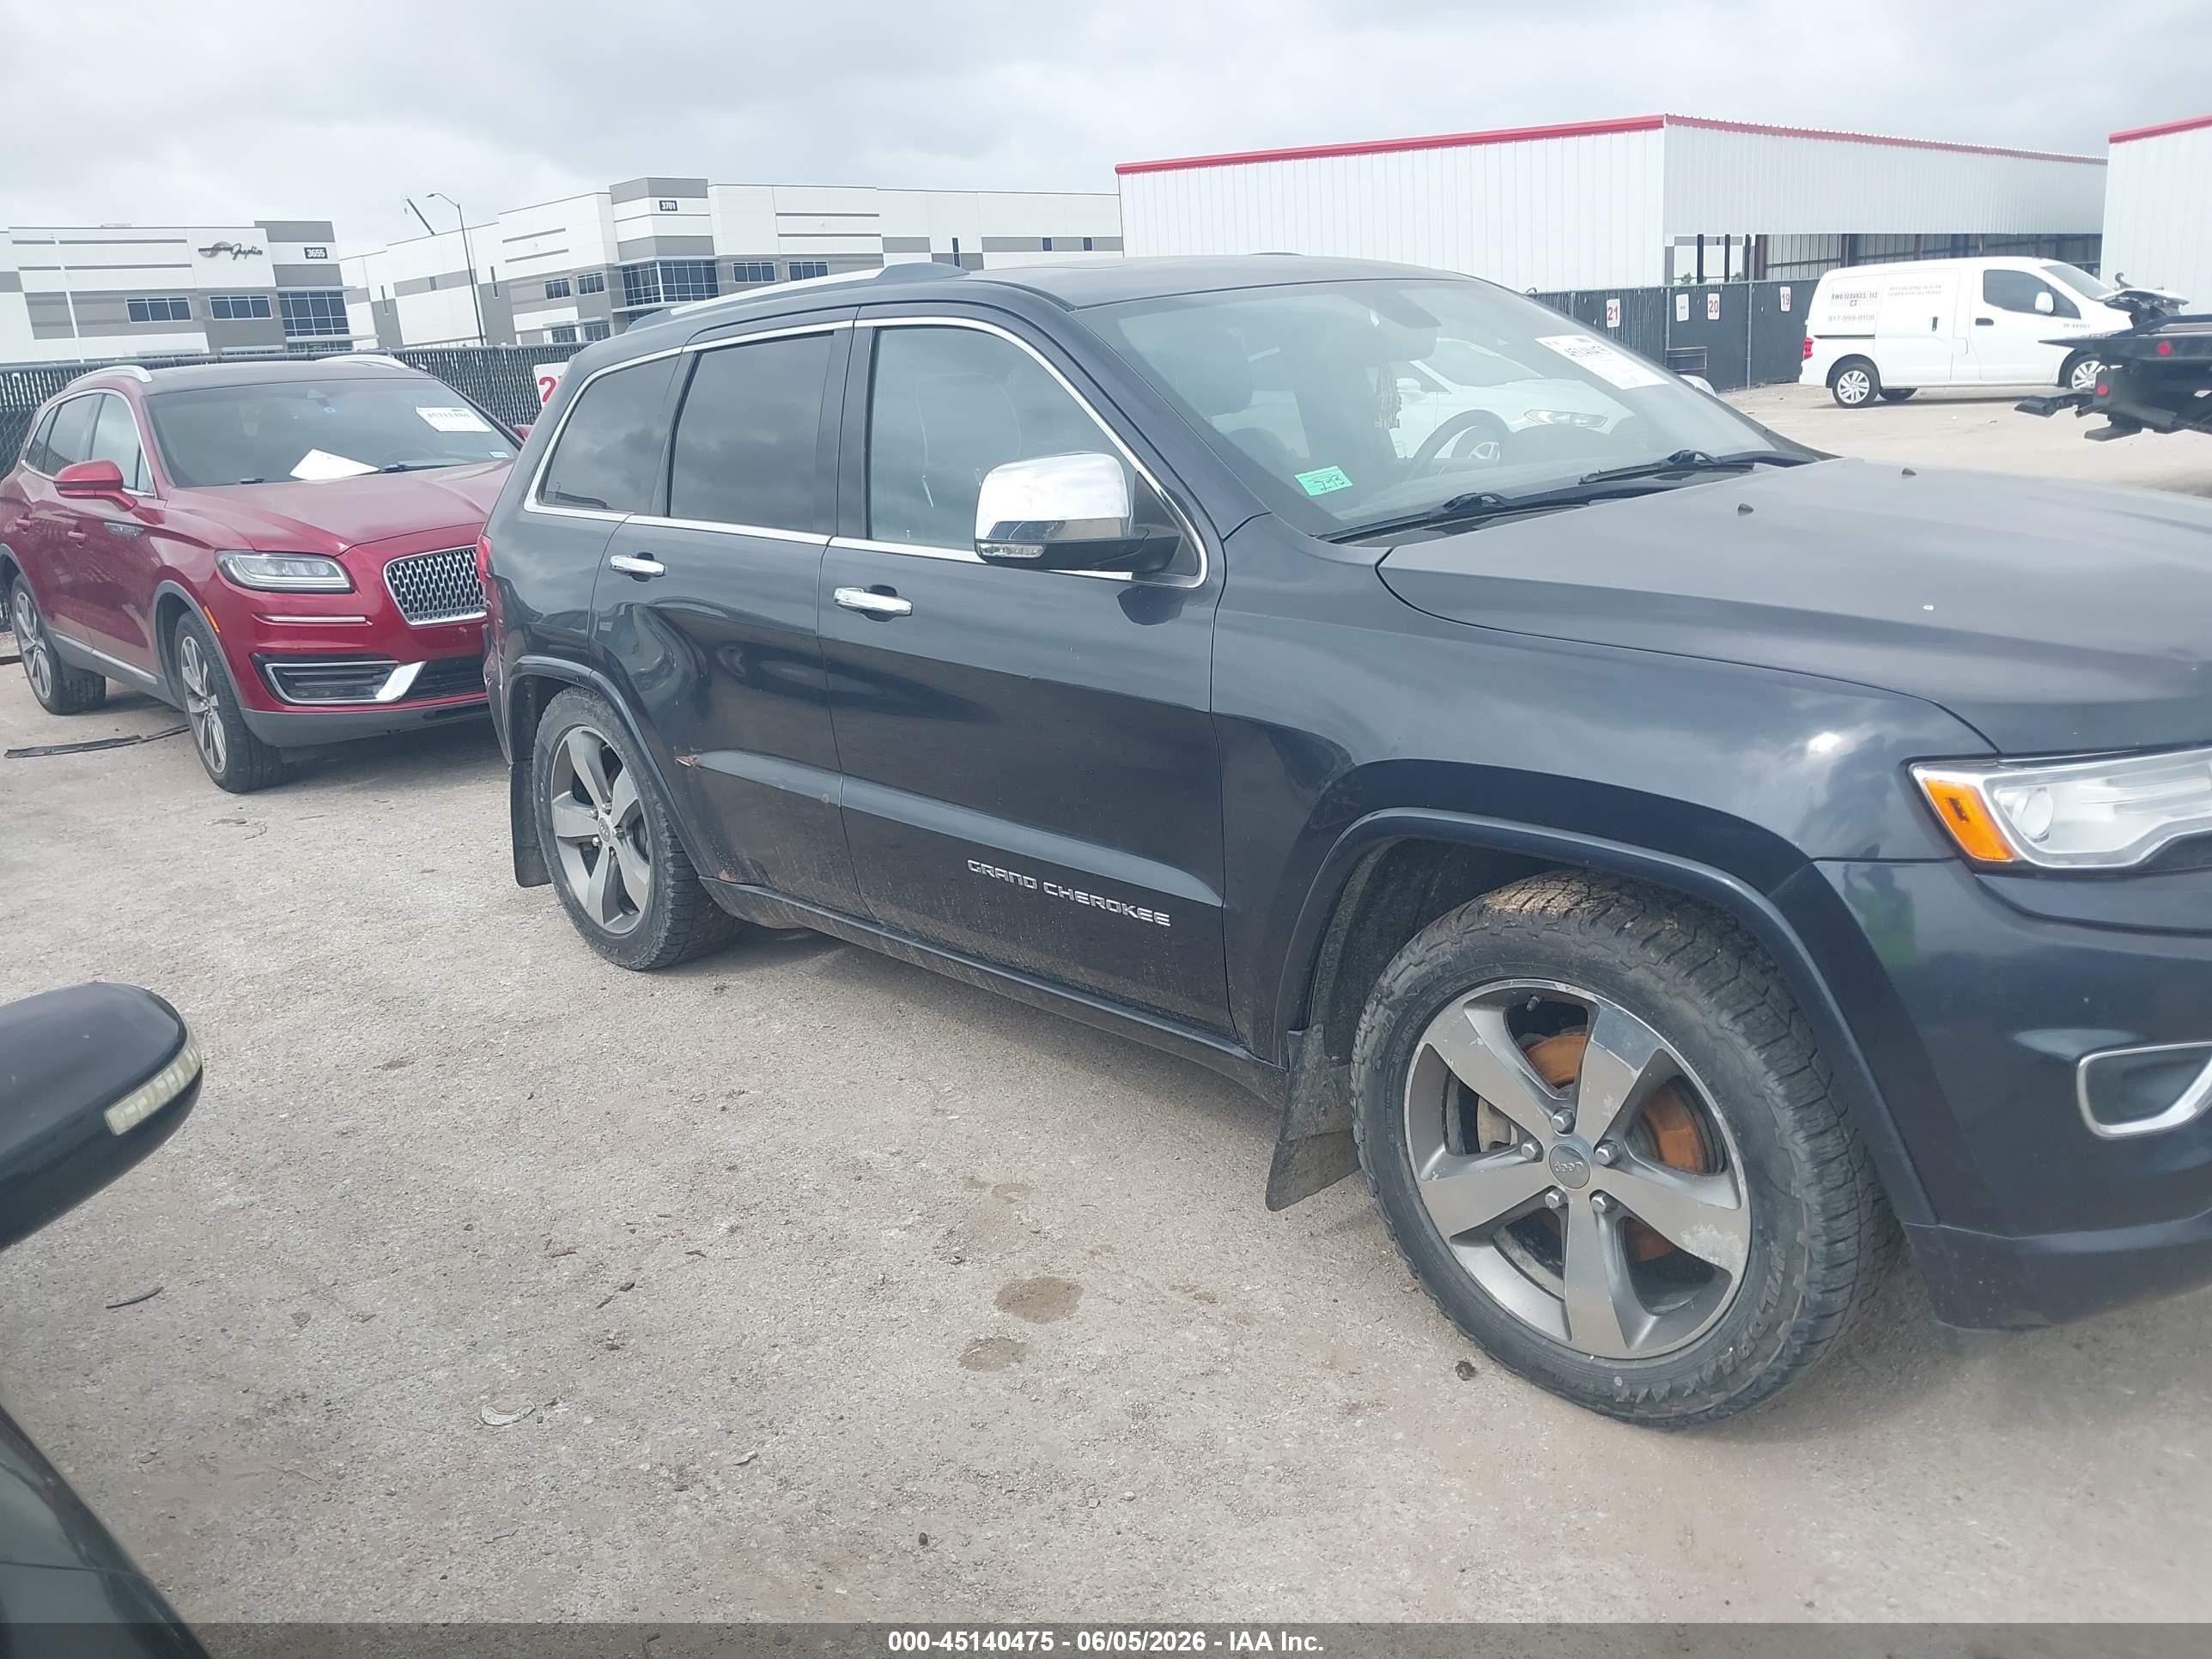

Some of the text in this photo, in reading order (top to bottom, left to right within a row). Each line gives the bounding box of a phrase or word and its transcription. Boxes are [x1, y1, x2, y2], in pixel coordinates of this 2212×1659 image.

[1782, 293, 1790, 306] 19
[1709, 300, 1719, 313] 20
[1607, 307, 1618, 320] 21
[967, 860, 1171, 927] GRAND CHEROKEE
